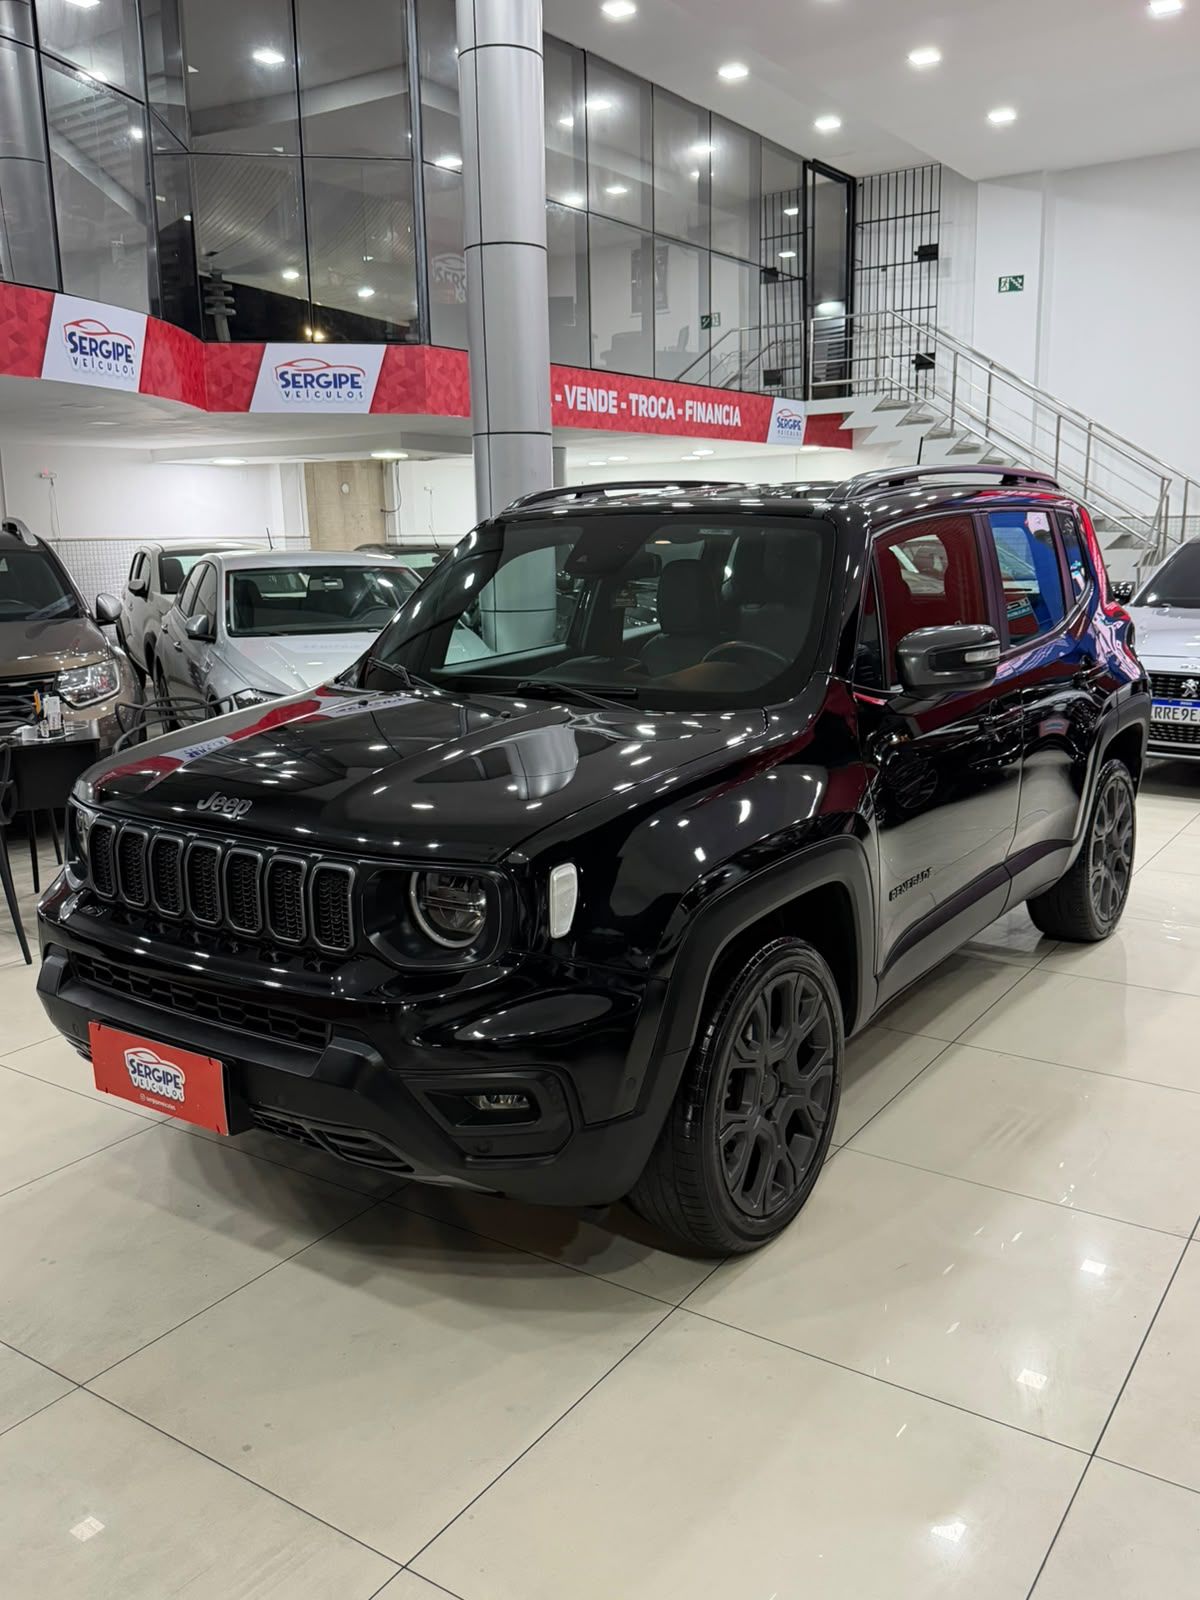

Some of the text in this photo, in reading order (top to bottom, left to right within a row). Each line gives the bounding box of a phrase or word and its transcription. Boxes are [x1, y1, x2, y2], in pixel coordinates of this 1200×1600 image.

[67, 331, 133, 364] SERGIPE
[278, 371, 362, 389] SERGIPE
[564, 384, 618, 414] VENDE
[628, 393, 676, 420] TROCA
[685, 400, 741, 427] FINANCIA
[1154, 706, 1200, 722] RRE9E
[196, 791, 253, 818] Jeep
[128, 1058, 182, 1090] SERGIPE
